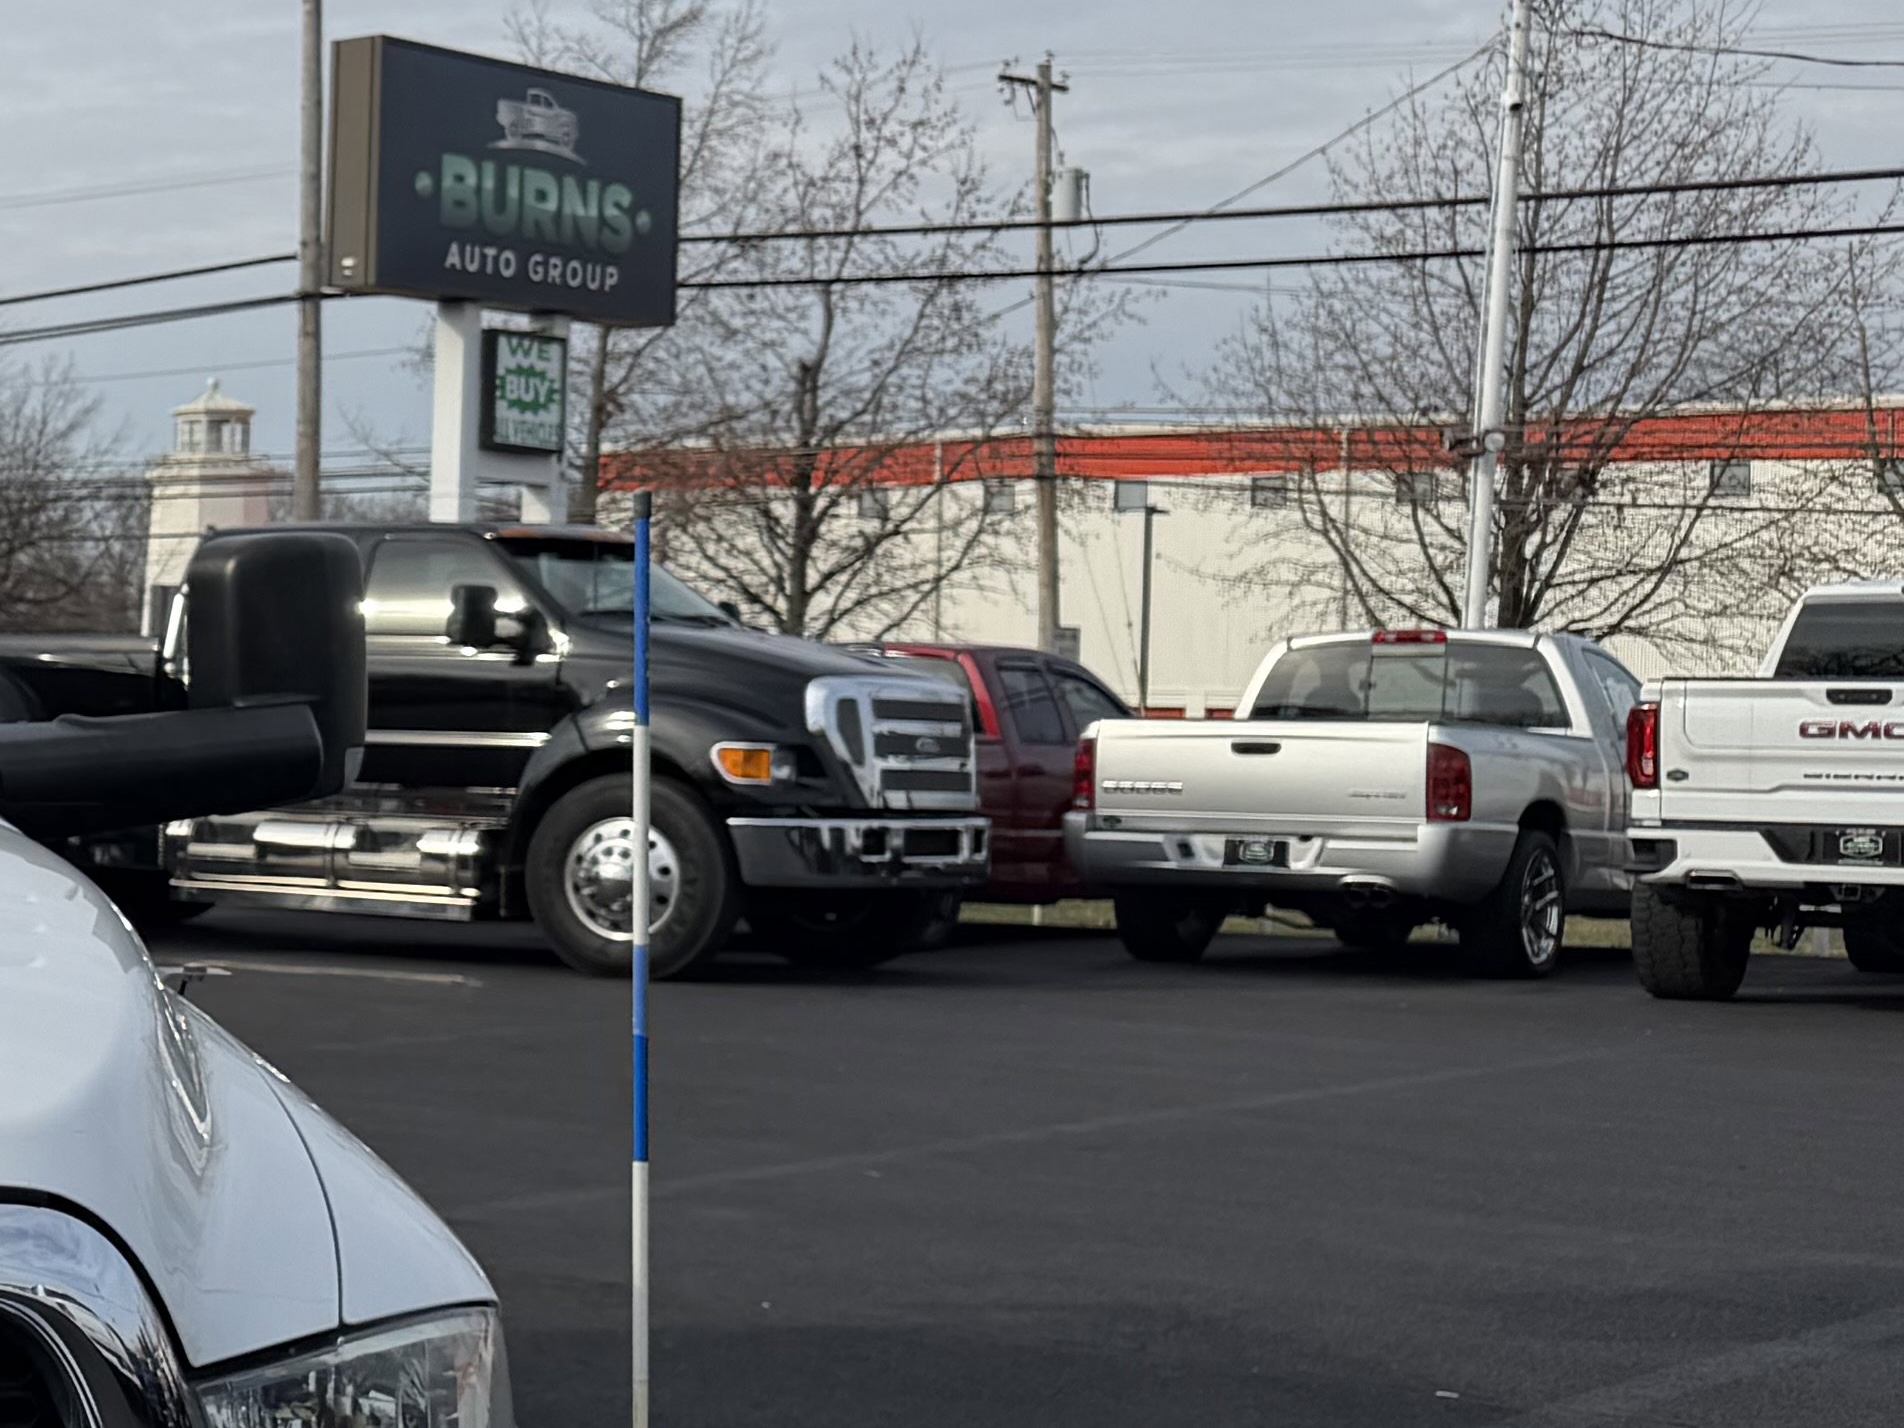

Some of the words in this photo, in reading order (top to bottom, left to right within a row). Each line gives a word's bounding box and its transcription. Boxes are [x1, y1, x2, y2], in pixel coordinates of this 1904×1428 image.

[441, 153, 634, 254] BURNS
[444, 240, 517, 278] AUTO
[527, 252, 619, 293] GROUP
[505, 334, 552, 363] WE
[505, 374, 550, 404] BUY
